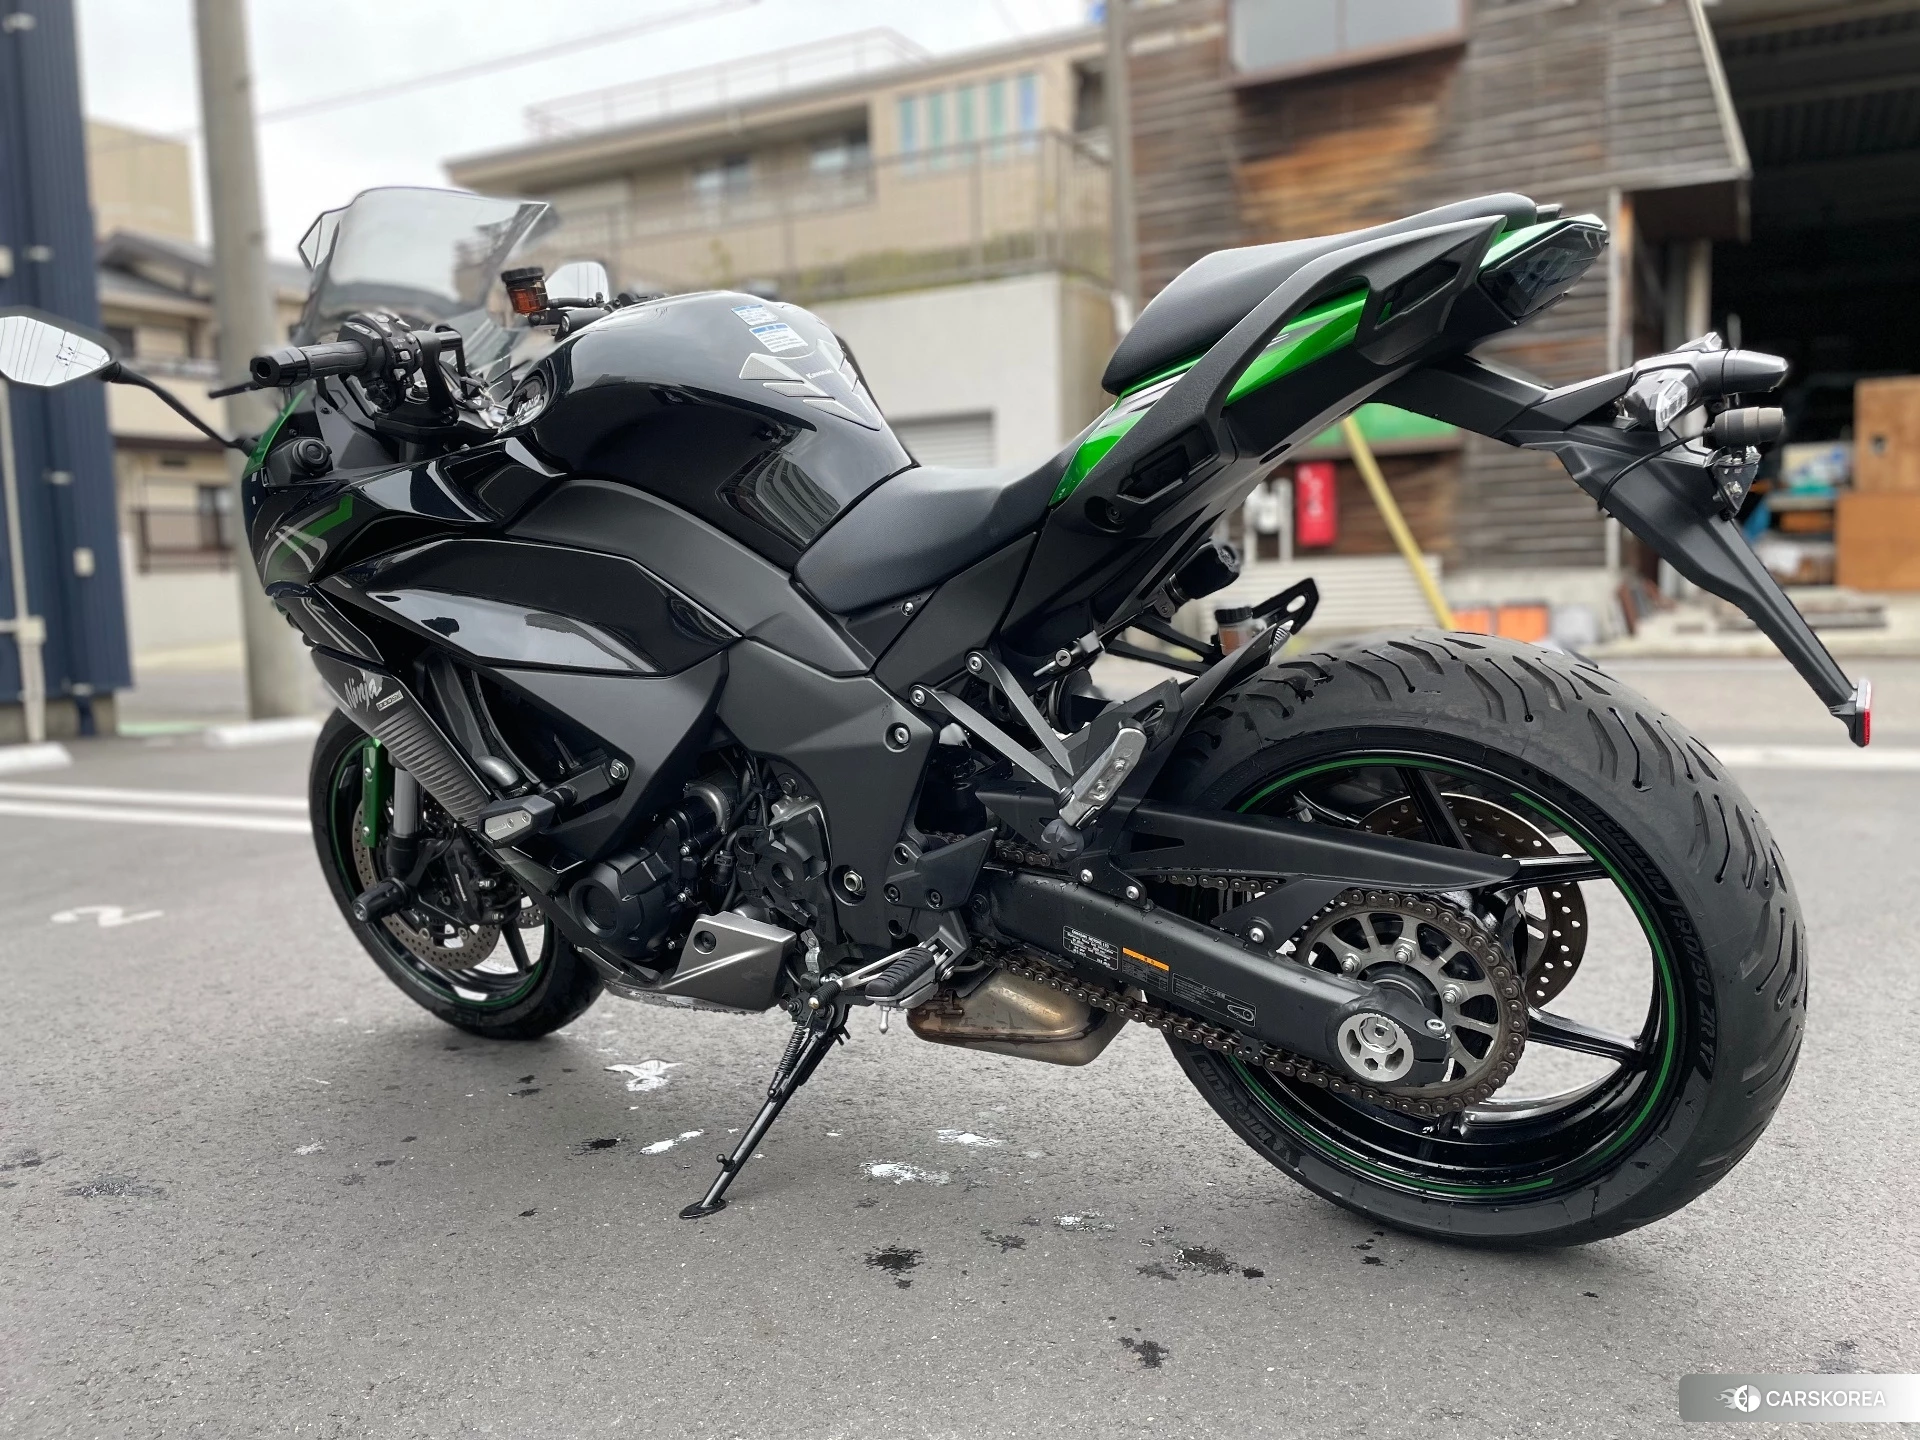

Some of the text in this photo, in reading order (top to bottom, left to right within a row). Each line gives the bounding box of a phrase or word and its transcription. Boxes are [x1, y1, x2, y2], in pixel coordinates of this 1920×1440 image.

[344, 672, 382, 712] Ninja
[1573, 797, 1669, 891] MICHELIN
[1669, 908, 1716, 1074] 190/50 ZR 17
